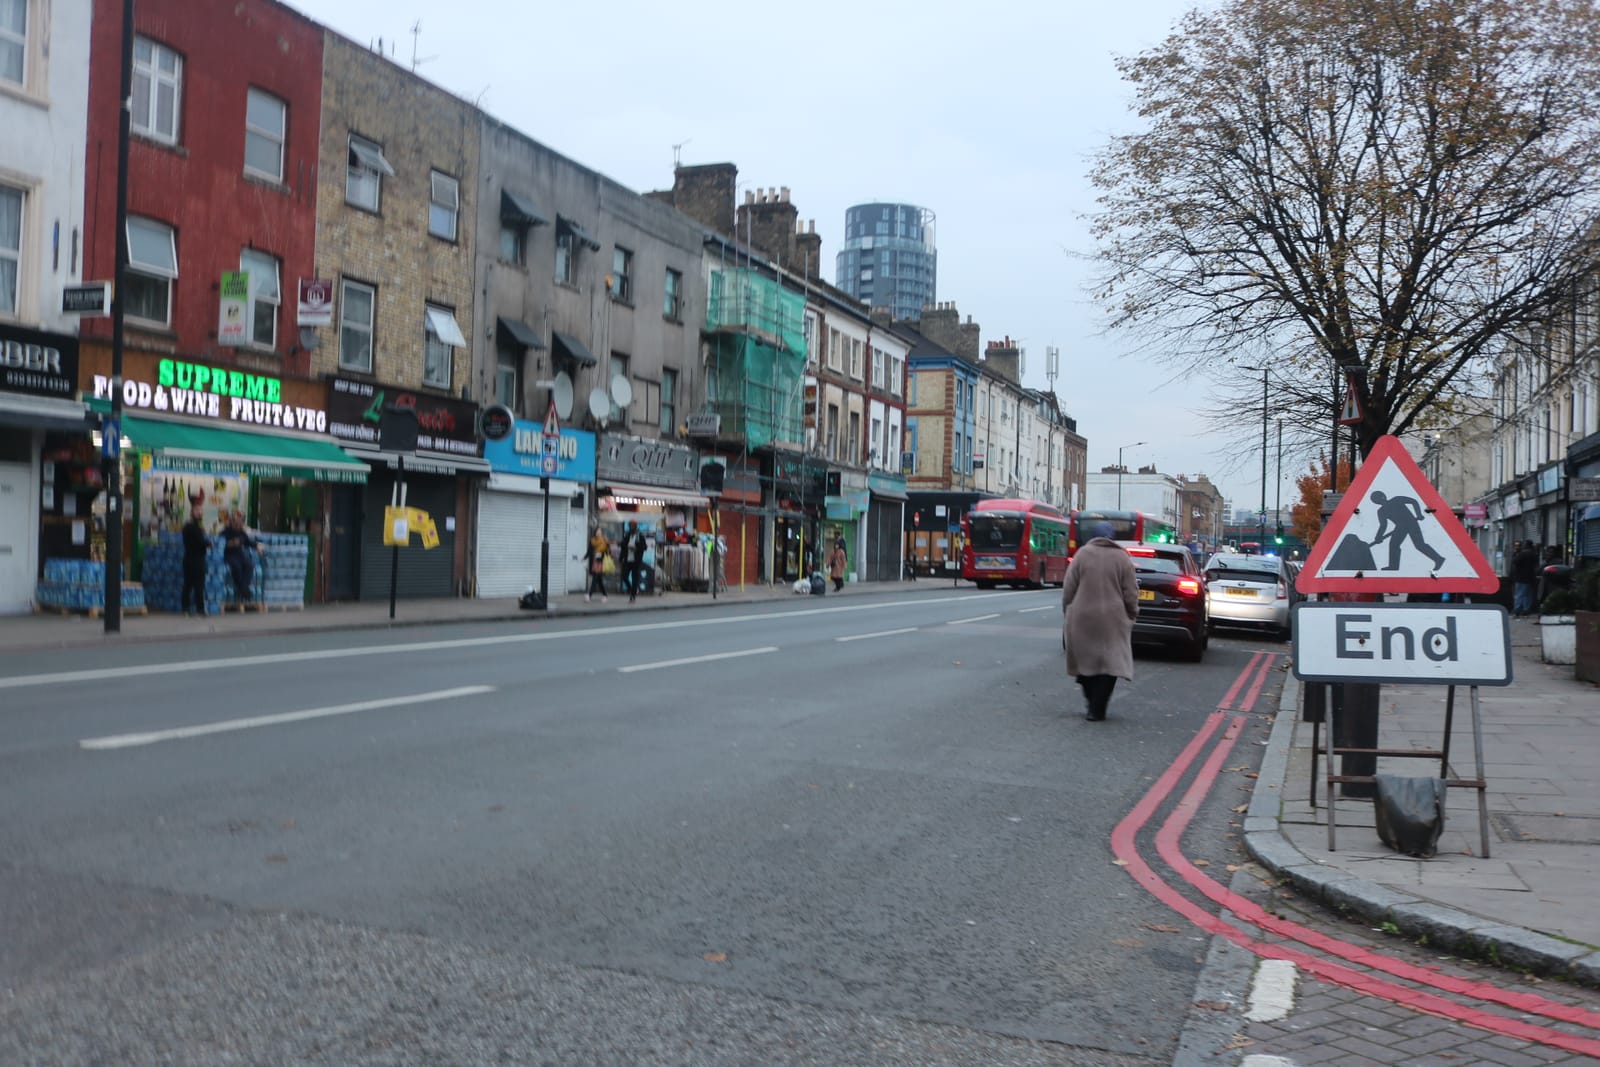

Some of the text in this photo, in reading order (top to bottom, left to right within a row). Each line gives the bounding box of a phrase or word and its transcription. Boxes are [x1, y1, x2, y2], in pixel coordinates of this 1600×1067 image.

[0, 340, 61, 374] BER
[158, 358, 281, 403] SUPREME
[515, 428, 577, 460] LANNO
[1336, 614, 1458, 662] End
